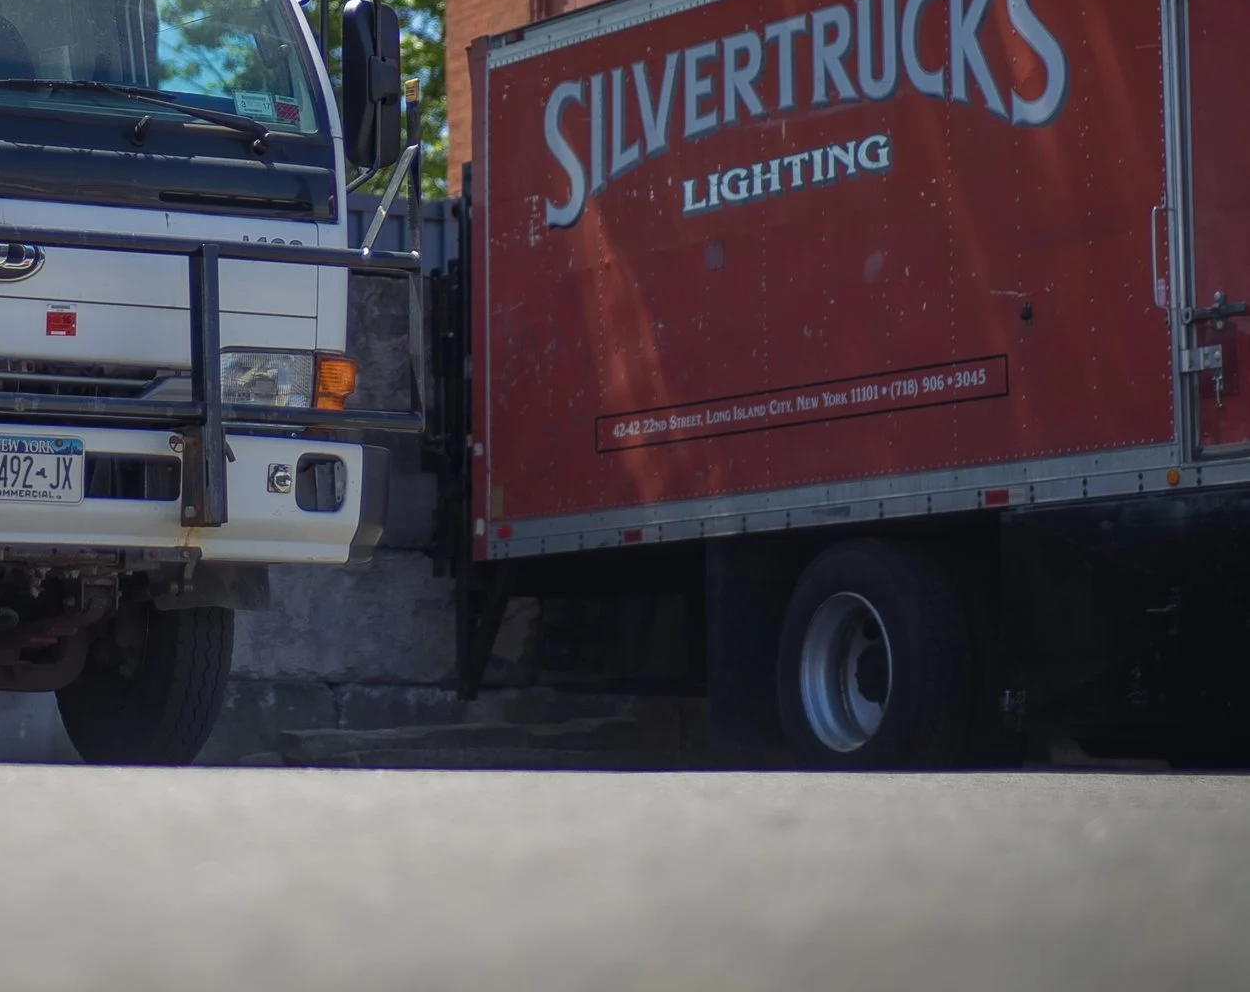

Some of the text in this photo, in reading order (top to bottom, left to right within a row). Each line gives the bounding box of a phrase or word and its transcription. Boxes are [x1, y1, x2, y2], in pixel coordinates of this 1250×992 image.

[682, 134, 892, 216] LIGHTING
[613, 421, 640, 438] 42-42
[850, 384, 878, 403] 11101
[890, 377, 919, 401] (718)
[922, 374, 944, 392] 906
[955, 368, 986, 388] 3045
[24, 439, 55, 454] YORK
